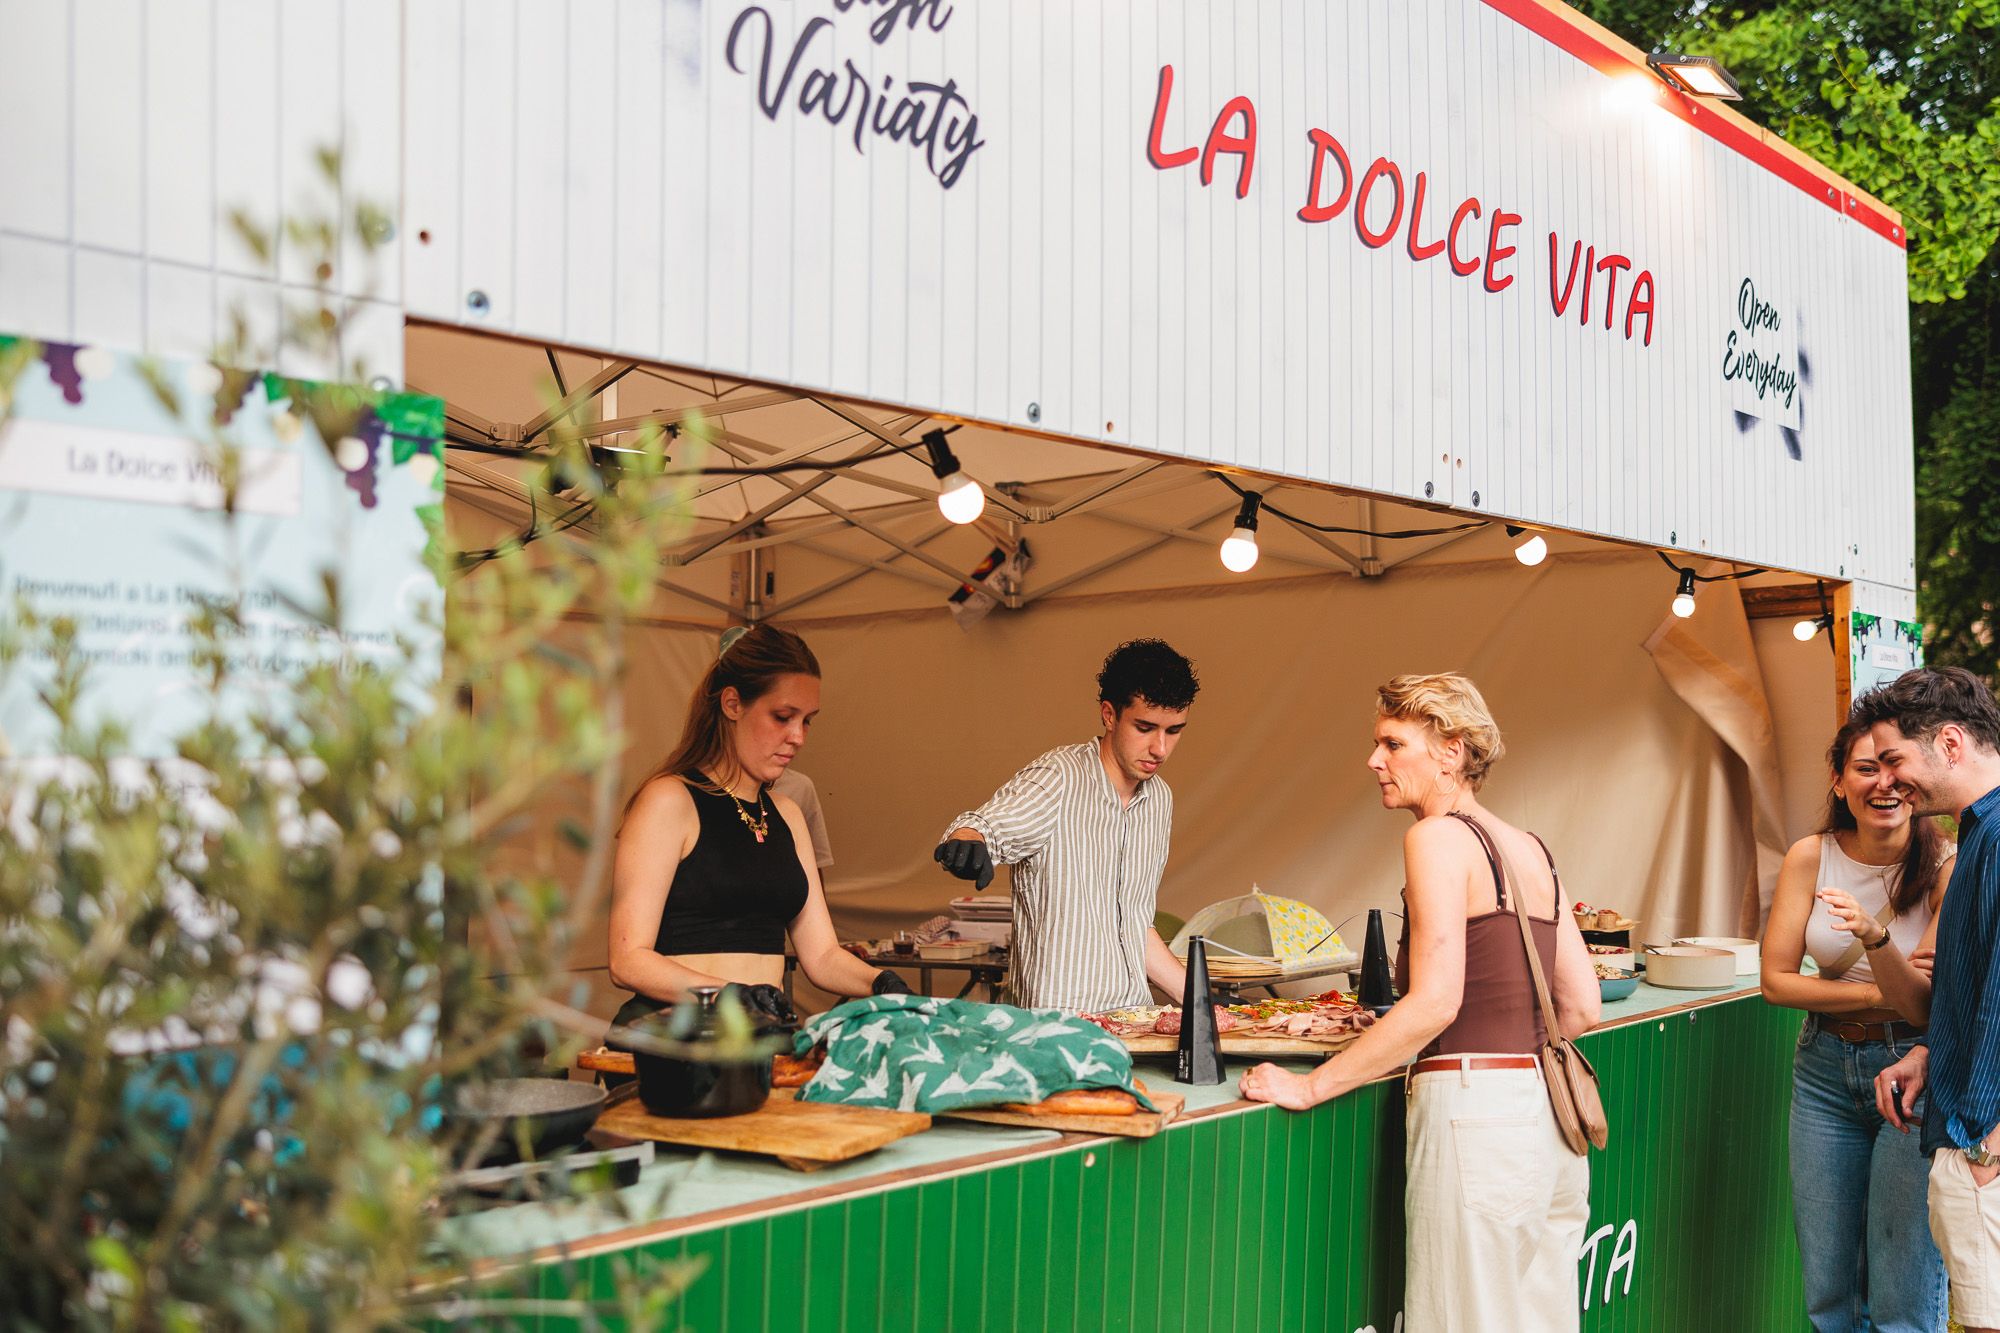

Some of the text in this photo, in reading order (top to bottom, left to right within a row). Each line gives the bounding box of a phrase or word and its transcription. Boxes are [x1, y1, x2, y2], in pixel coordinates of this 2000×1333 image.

[726, 7, 985, 190] Variaty
[1146, 64, 1655, 347] LA DOLCE VITA
[1738, 277, 1781, 337] Open
[1723, 330, 1797, 409] Everyday
[1577, 1219, 1638, 1313] TA
